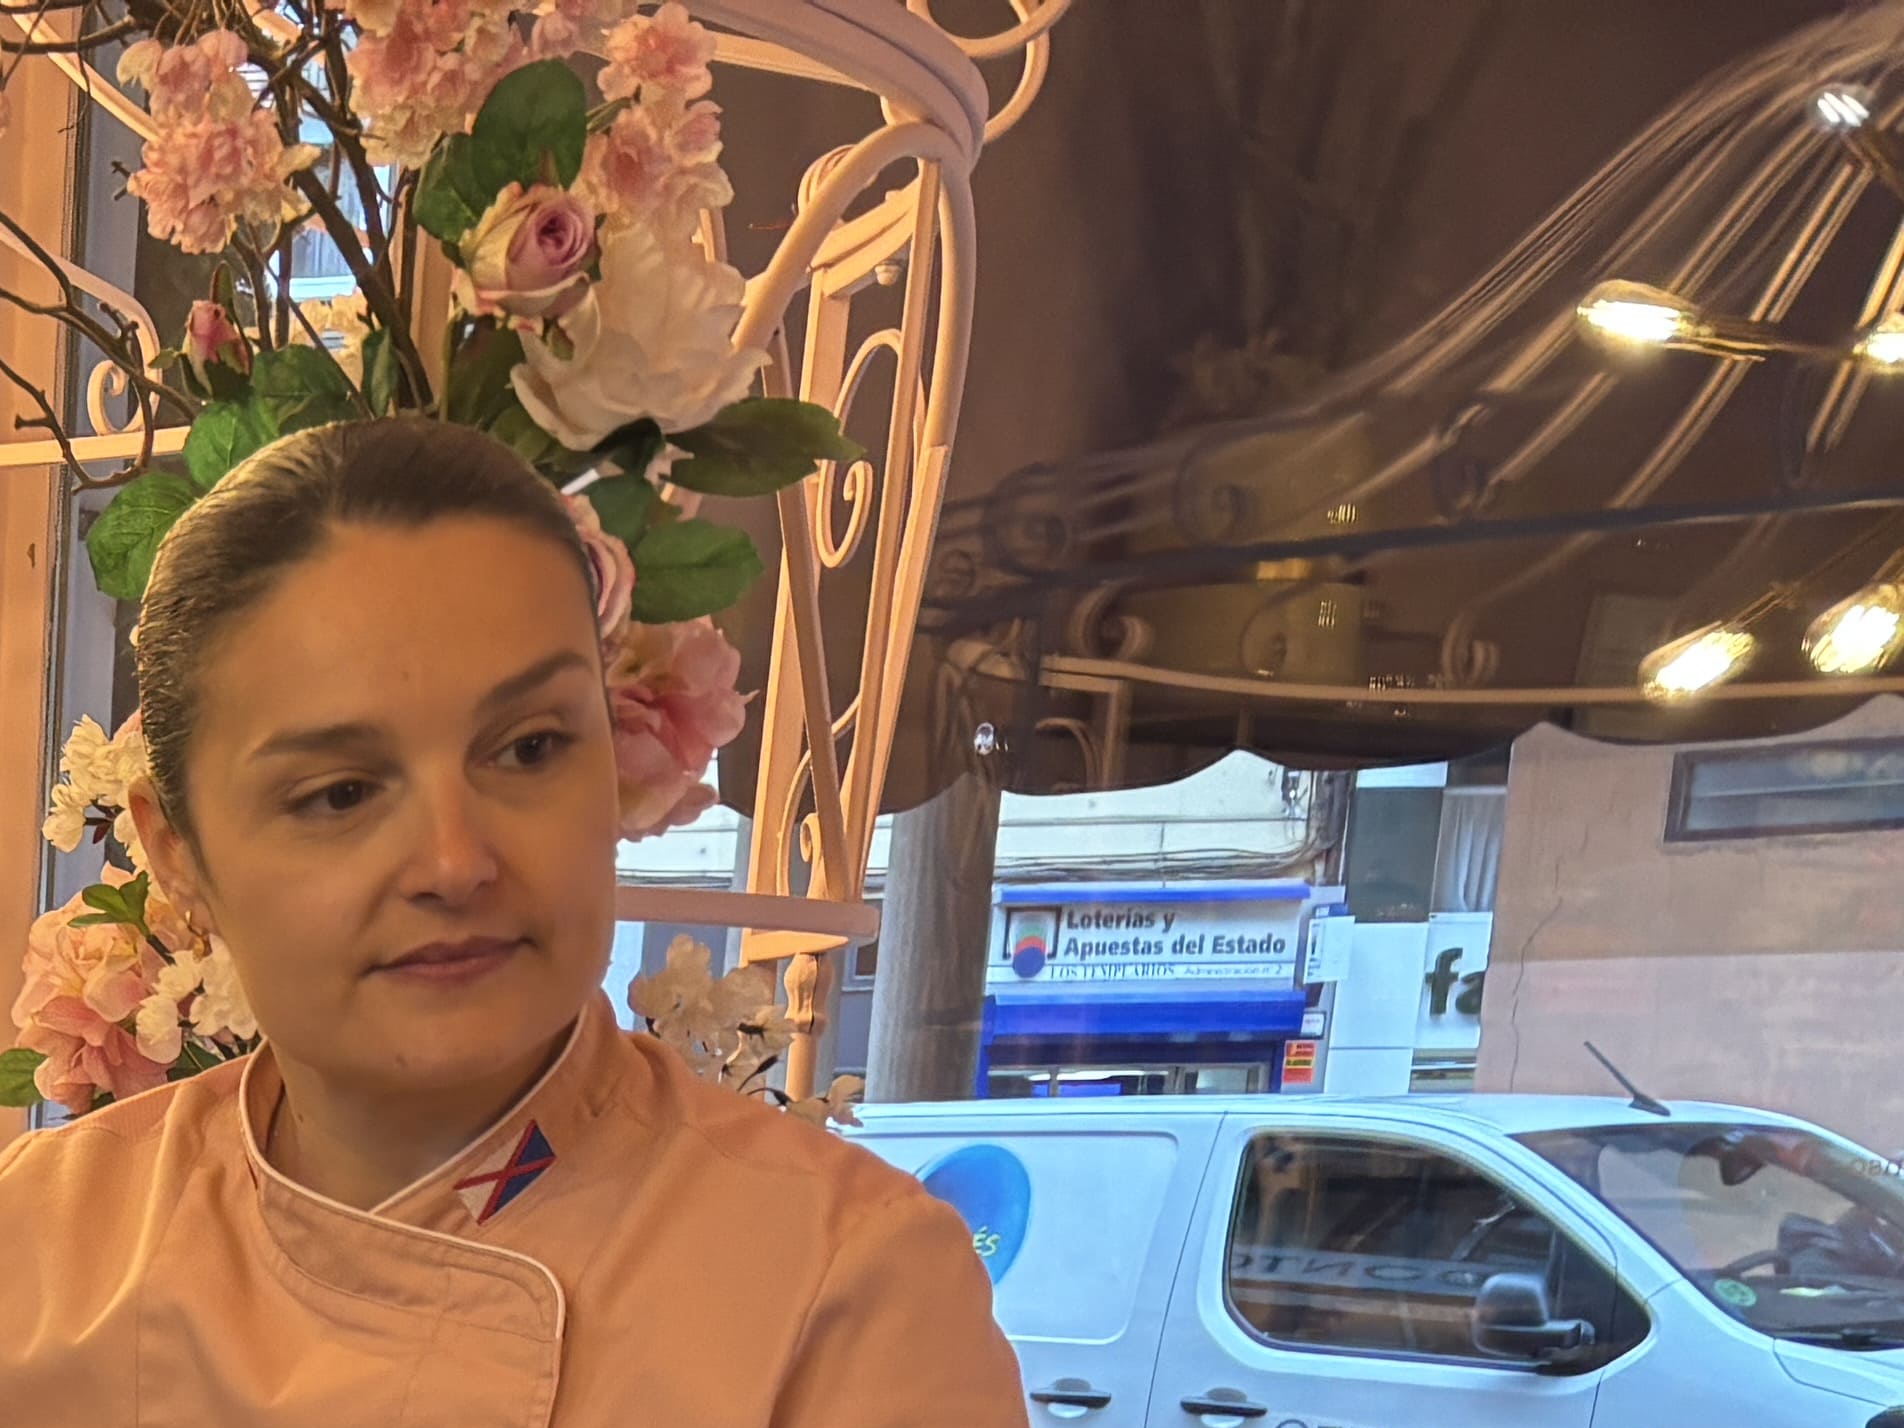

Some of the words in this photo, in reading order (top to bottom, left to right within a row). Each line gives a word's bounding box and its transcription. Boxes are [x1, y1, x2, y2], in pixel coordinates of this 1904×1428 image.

[1066, 907, 1155, 931] Loterías
[1162, 912, 1175, 934] y
[1064, 935, 1172, 961] Apuestas
[1175, 933, 1205, 956] del
[1212, 933, 1287, 957] Estado
